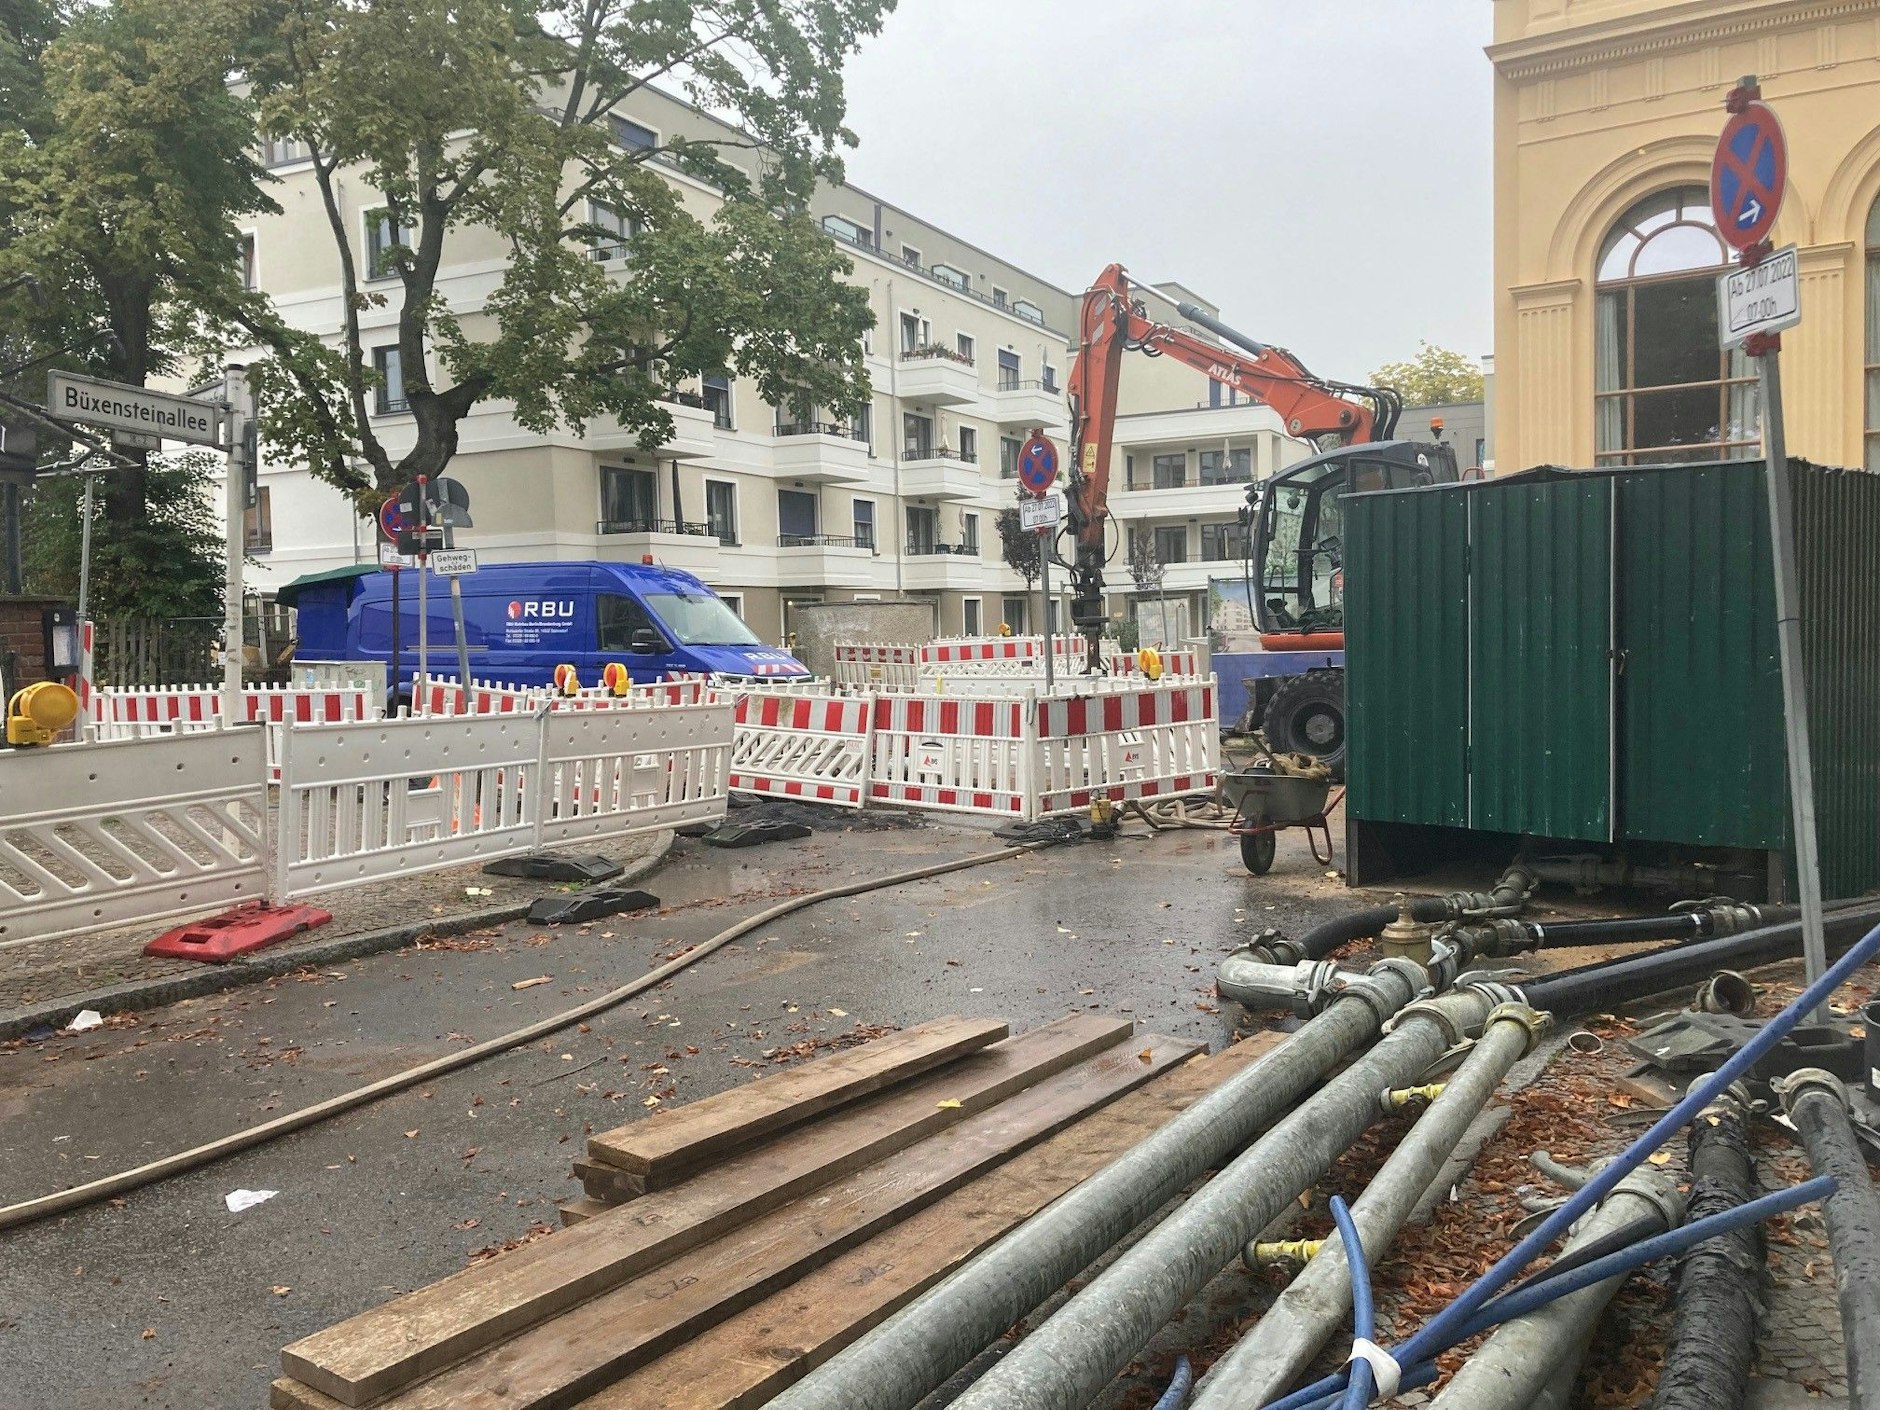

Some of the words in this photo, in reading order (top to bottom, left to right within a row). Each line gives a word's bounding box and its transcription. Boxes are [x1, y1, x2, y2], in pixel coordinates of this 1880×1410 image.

[1731, 277, 1743, 298] Ab
[1208, 363, 1241, 385] ATLAS
[65, 386, 207, 432] Büxensteinallee
[437, 554, 471, 562] Gehweg-
[440, 561, 471, 572] schäden
[524, 601, 574, 617] RBU
